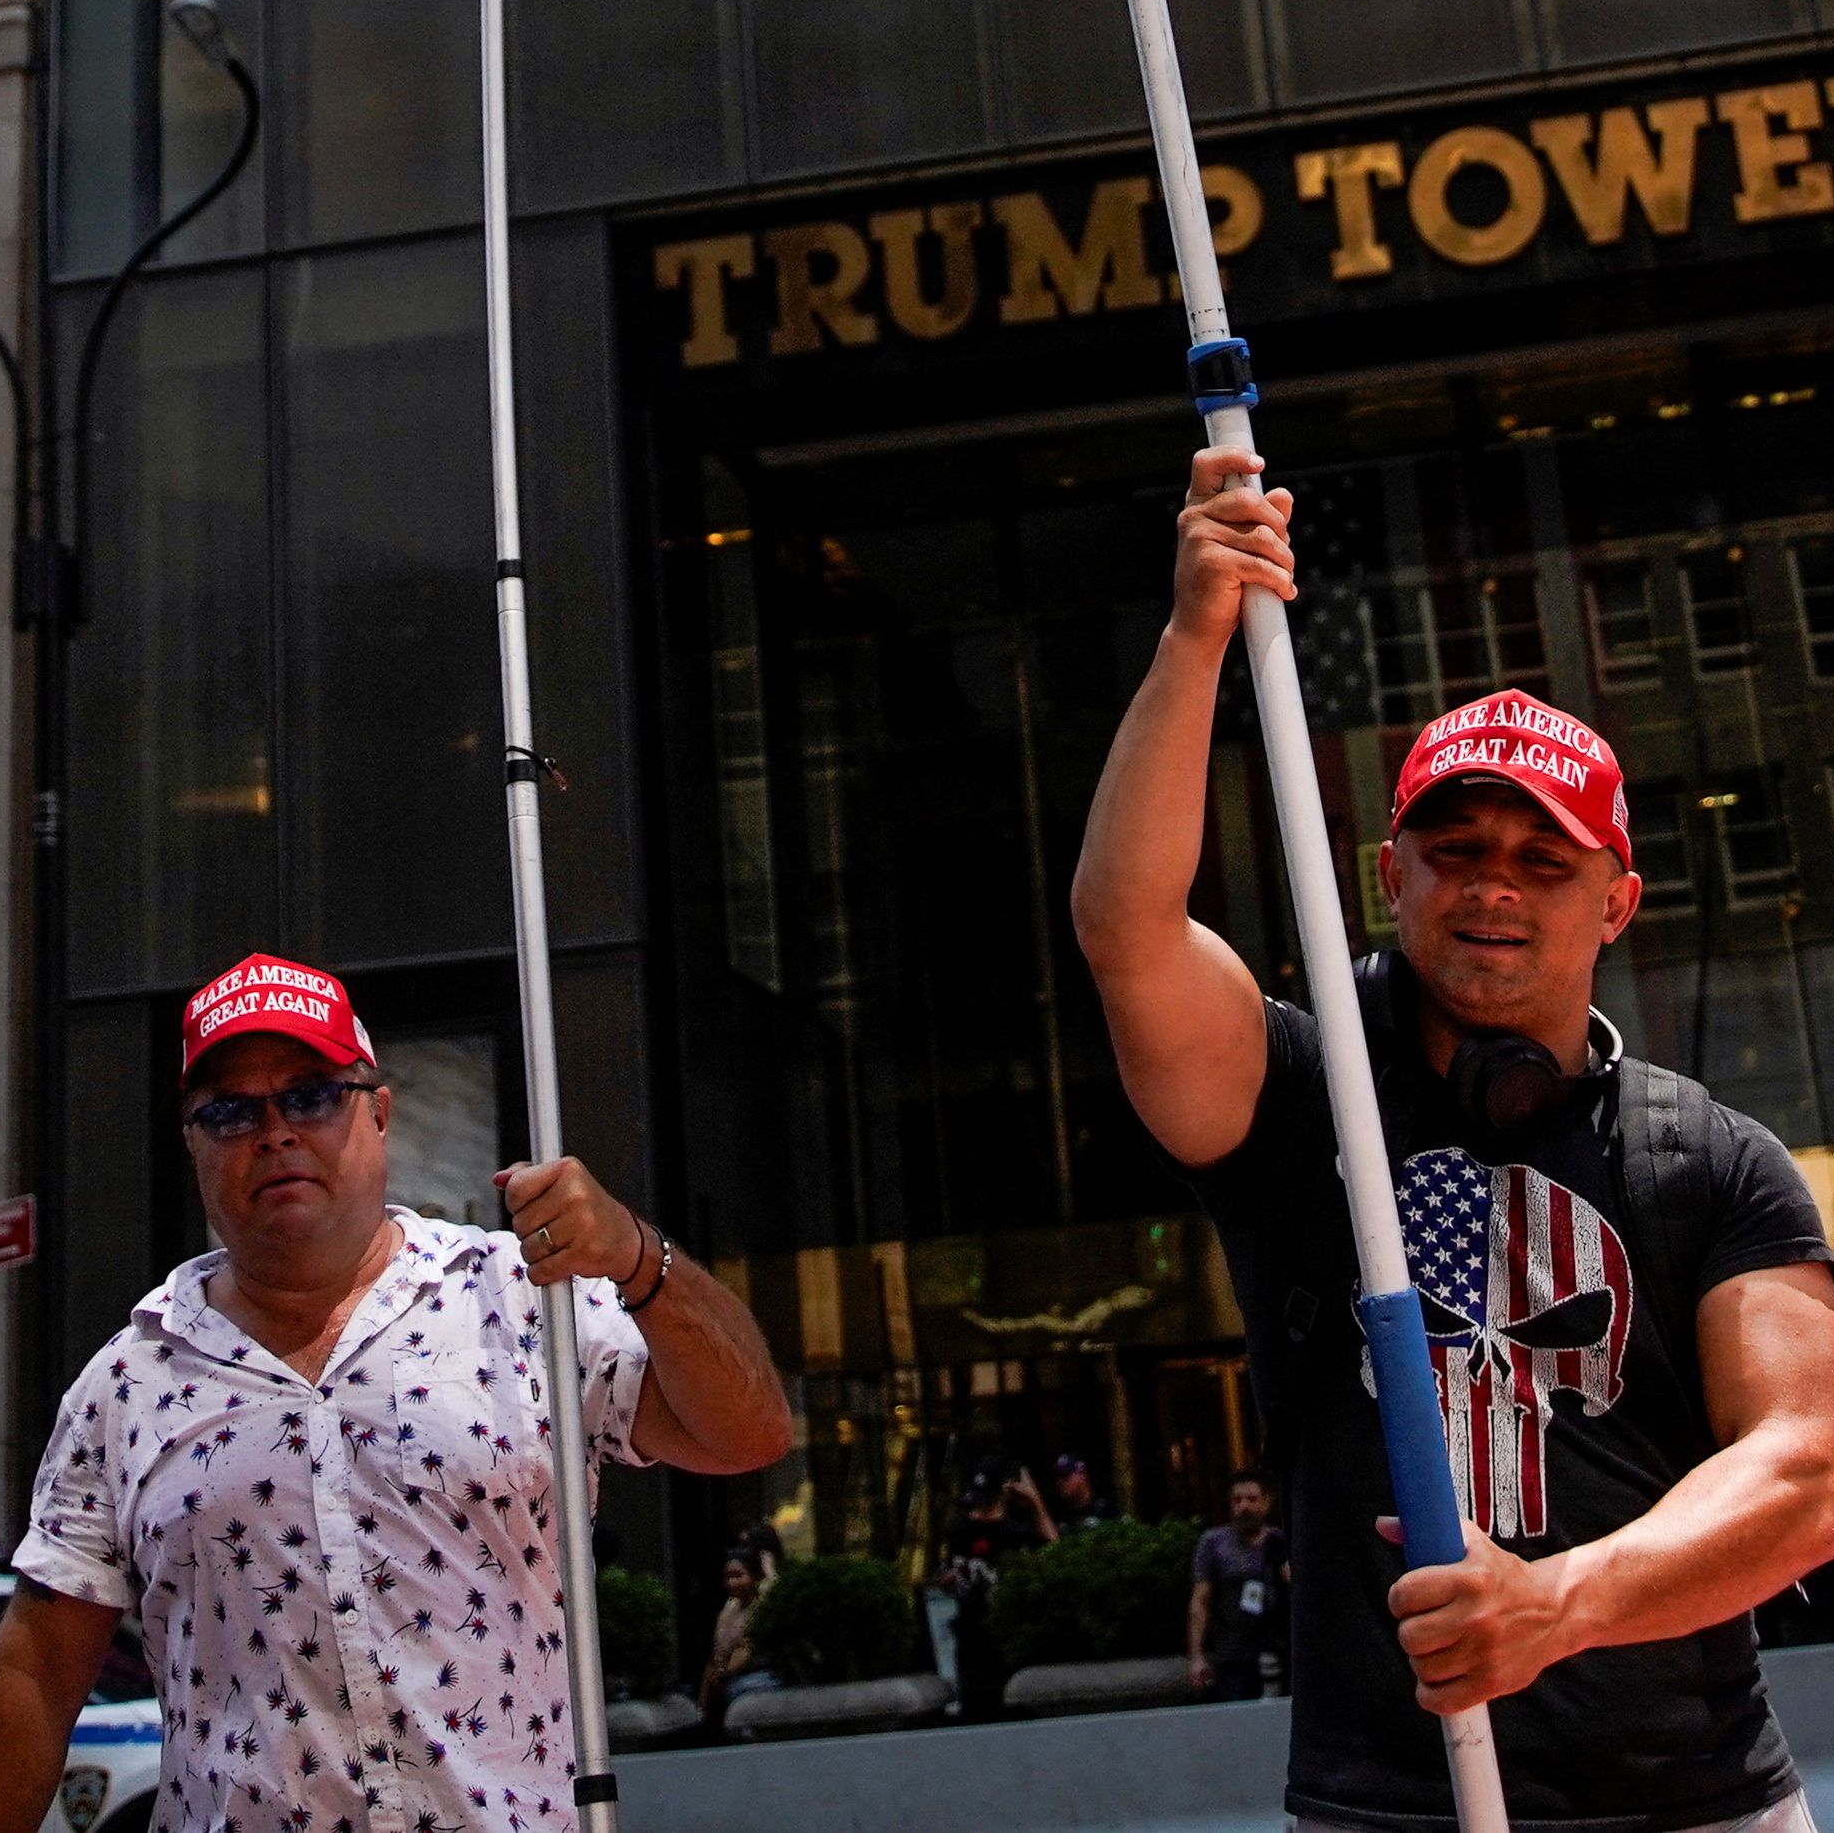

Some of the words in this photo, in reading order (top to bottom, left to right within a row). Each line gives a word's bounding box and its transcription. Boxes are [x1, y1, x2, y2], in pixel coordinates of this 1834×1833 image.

[1424, 703, 1490, 749] MAKE
[1491, 701, 1605, 765] AMERICA
[1430, 738, 1506, 776] GREAT
[1507, 739, 1590, 794] AGAIN
[191, 970, 244, 1020] MAKE
[244, 964, 339, 1003] AMERICA
[199, 991, 260, 1038] GREAT
[263, 990, 330, 1024] AGAIN
